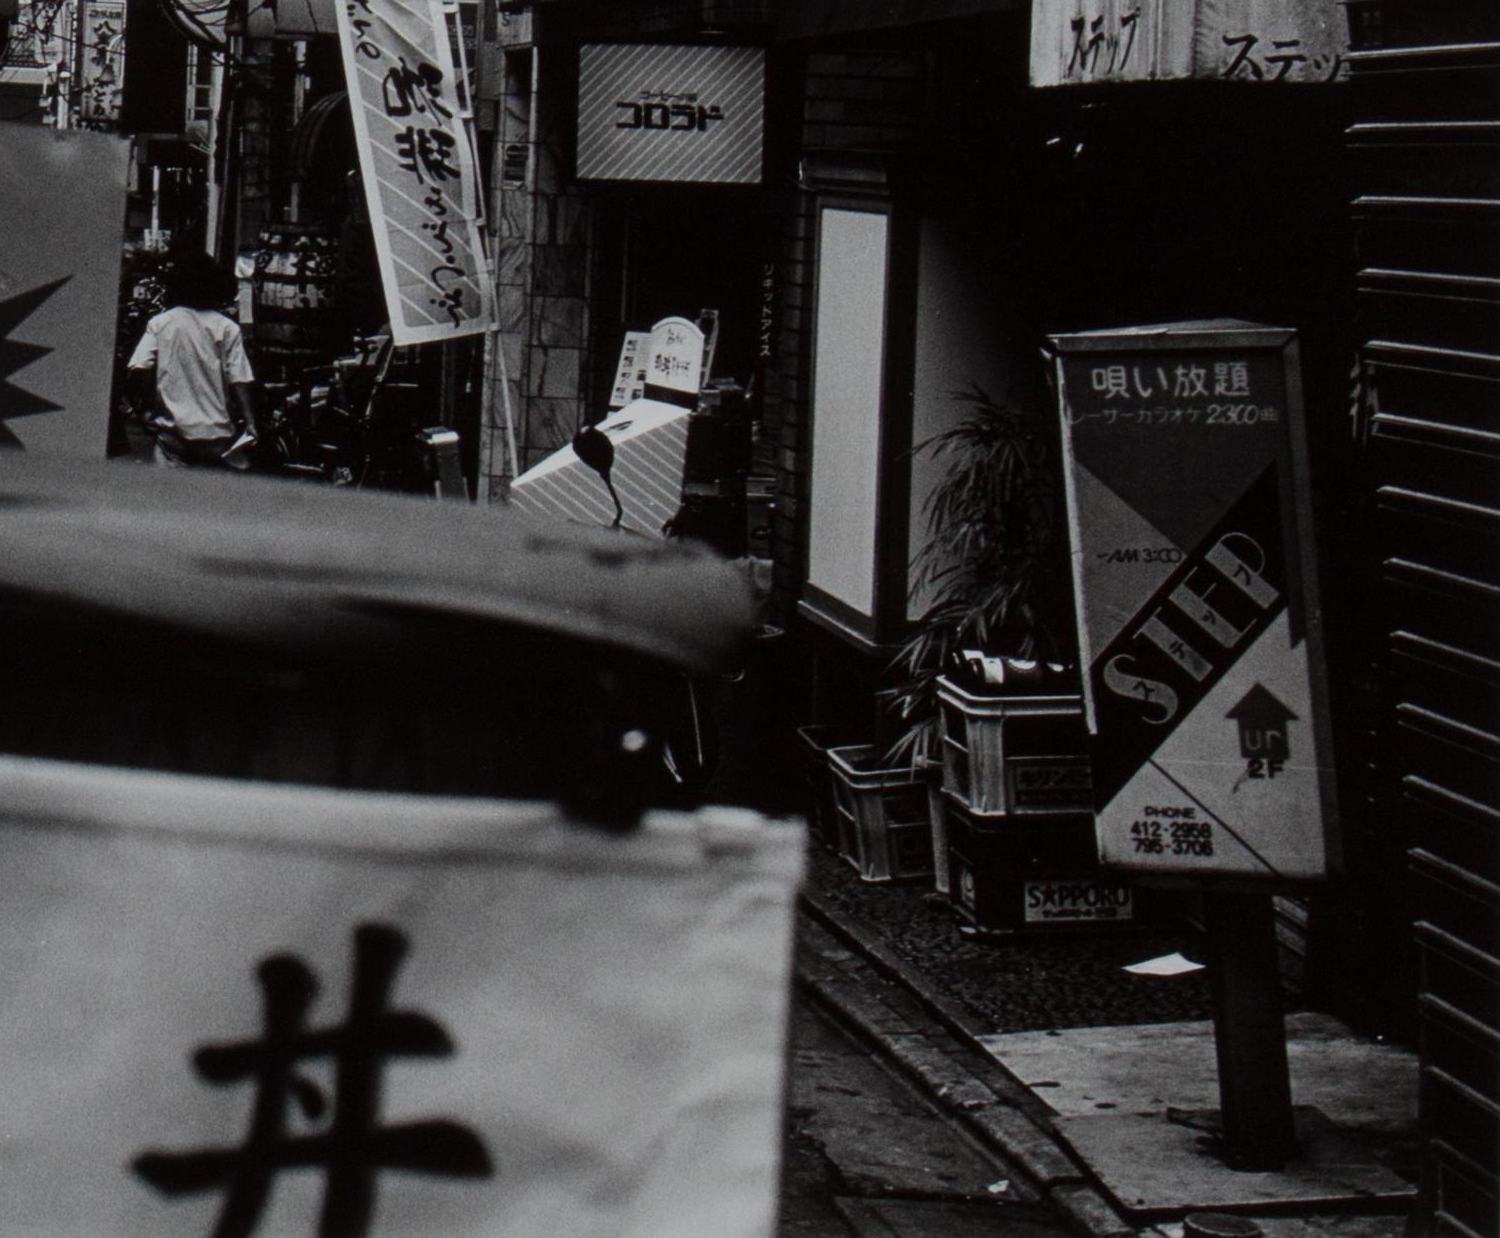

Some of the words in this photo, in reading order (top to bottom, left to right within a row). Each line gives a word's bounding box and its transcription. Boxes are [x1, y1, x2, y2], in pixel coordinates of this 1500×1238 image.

[1067, 6, 1141, 73] ステップ
[616, 101, 725, 132] コロラド
[1091, 362, 1252, 401] 唄い放題
[1103, 530, 1284, 725] STEP
[1247, 758, 1284, 779] 2F
[1143, 806, 1195, 820] PHONE
